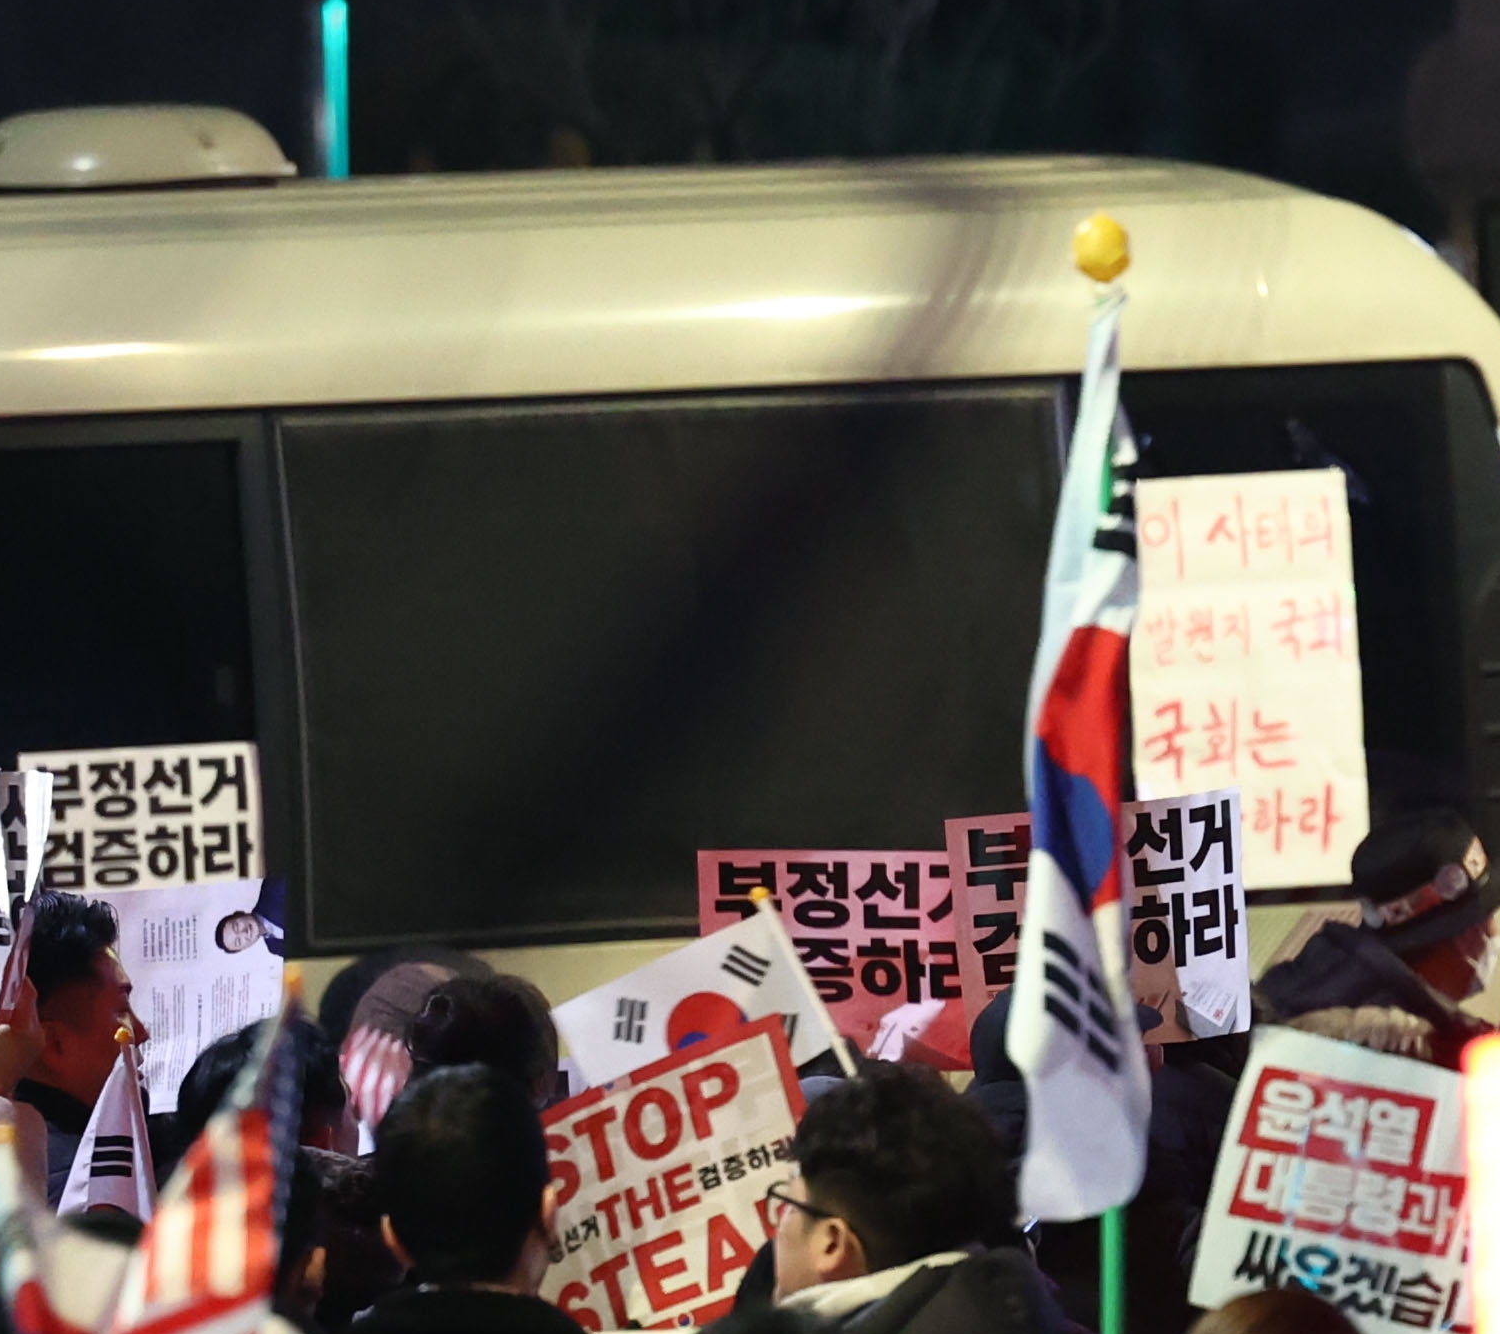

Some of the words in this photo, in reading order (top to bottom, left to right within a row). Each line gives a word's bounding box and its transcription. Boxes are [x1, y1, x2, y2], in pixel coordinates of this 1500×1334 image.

[1140, 495, 1185, 580] 이
[1141, 696, 1299, 782] 국회는
[35, 753, 248, 820] 부정선거
[42, 821, 254, 890] 검증하라
[967, 798, 1234, 901] 부선거
[546, 1061, 740, 1207] STOP
[1256, 1078, 1420, 1166] 윤석열
[595, 1163, 702, 1241] THE
[1241, 1153, 1454, 1246] 대통령과
